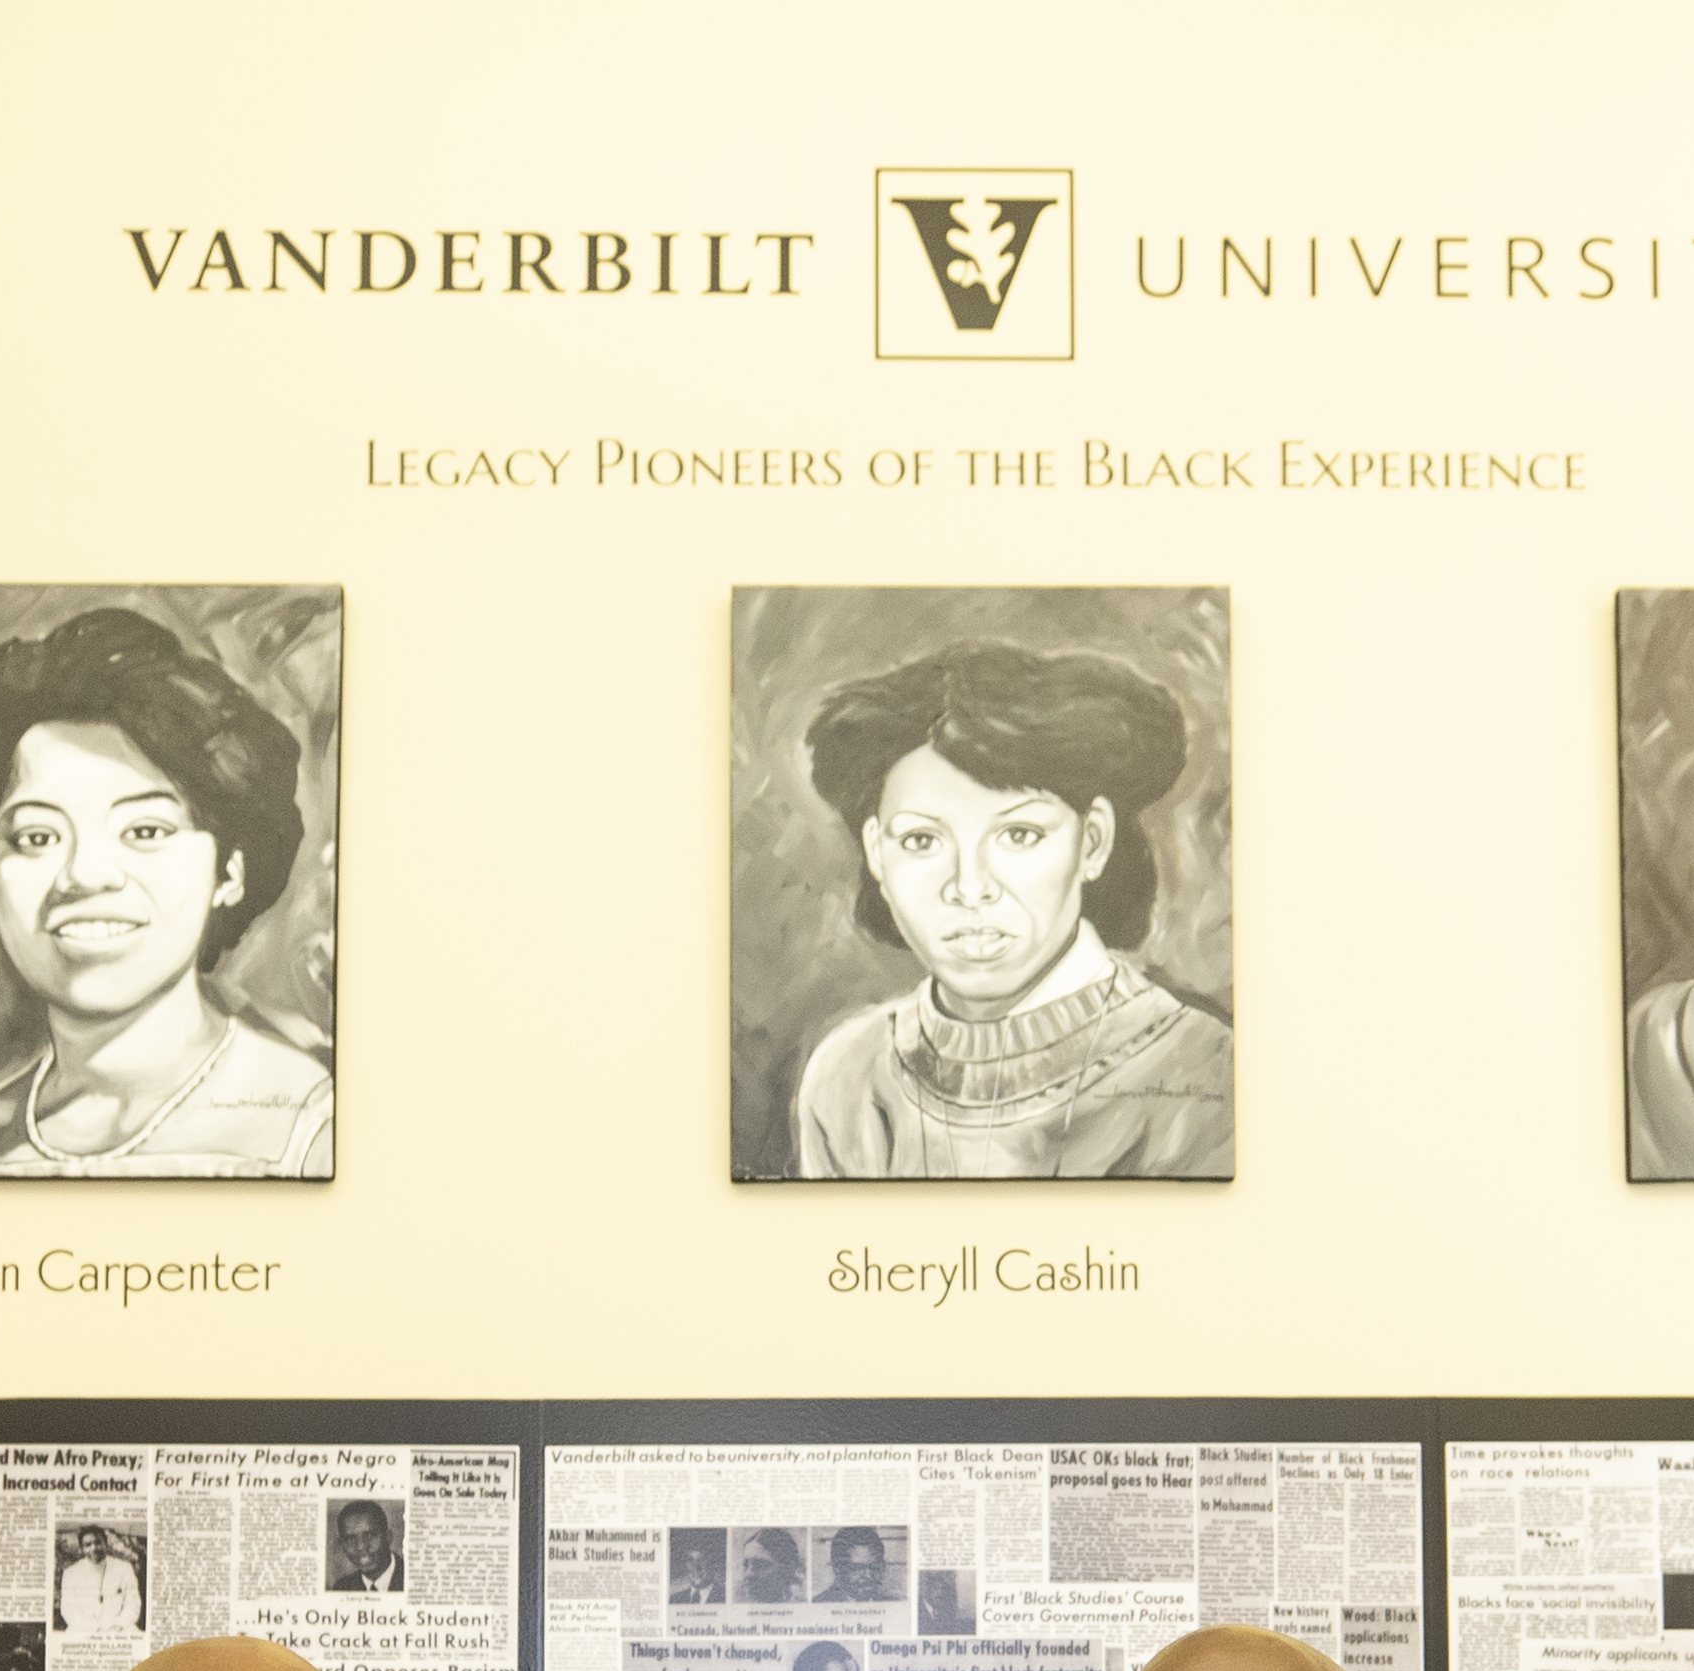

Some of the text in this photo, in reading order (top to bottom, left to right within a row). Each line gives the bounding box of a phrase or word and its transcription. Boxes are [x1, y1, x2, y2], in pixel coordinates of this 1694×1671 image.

[128, 230, 813, 293] VANDERBILT
[38, 1249, 280, 1308] Carpenter
[828, 1246, 1138, 1308] Sheryll Cashin
[12, 1449, 50, 1466] New
[53, 1449, 89, 1467] Afro
[154, 1449, 397, 1470] Fraternity Pledges Negro
[550, 1447, 637, 1465] Vanderbilt
[638, 1447, 686, 1463] asked
[688, 1452, 704, 1464] to
[705, 1449, 727, 1464] be
[805, 1450, 832, 1462] not
[832, 1447, 912, 1465] plantation
[1050, 1450, 1087, 1466] USAC
[1092, 1451, 1120, 1467] OKs
[1124, 1451, 1159, 1468] black
[1451, 1444, 1634, 1462] Time provokes thoughts
[2, 1474, 76, 1492] Increased
[79, 1475, 138, 1493] Contact
[154, 1472, 183, 1489] For
[191, 1472, 231, 1489] First
[237, 1472, 283, 1488] Time
[289, 1475, 310, 1488] at
[1049, 1472, 1109, 1489] proposal
[1110, 1476, 1143, 1491] goes
[1144, 1475, 1159, 1488] to
